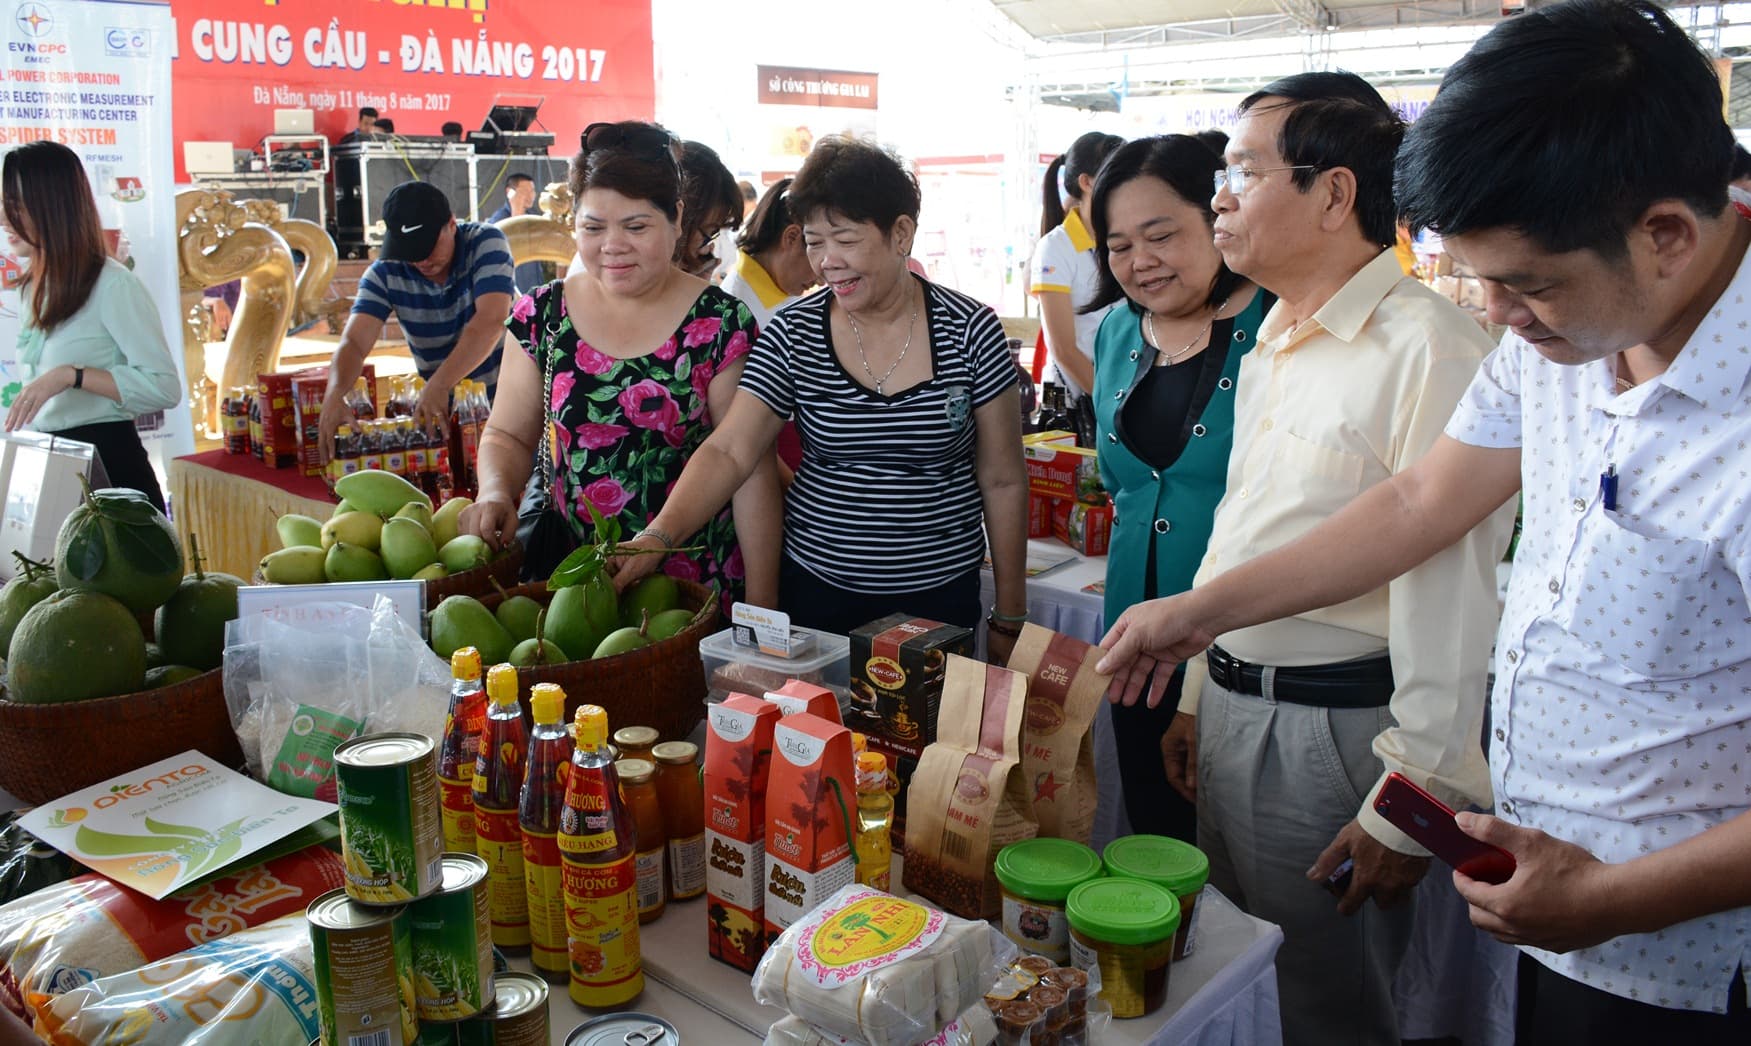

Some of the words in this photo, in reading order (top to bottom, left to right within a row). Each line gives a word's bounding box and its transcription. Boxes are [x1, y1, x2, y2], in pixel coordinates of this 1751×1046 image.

[191, 18, 293, 66] CUNG
[303, 16, 367, 71] CẦU
[399, 28, 445, 75] ĐÀ
[451, 29, 535, 80] NẴNG
[541, 44, 607, 82] 2017
[7, 70, 45, 83] POWER
[47, 72, 121, 86] CORPORATION
[13, 90, 78, 105] ELECTRONIC
[80, 92, 155, 107] MEASUREMENT
[253, 86, 271, 106] Đà
[308, 93, 338, 112] ngày
[339, 90, 353, 108] 11
[356, 91, 388, 113] tháng
[389, 92, 398, 109] 8
[424, 93, 452, 111] 2017
[7, 106, 97, 121] MANUFACTURING
[98, 108, 138, 121] CENTER
[0, 127, 52, 145] SPIDER
[57, 128, 117, 146] SYSTEM
[1039, 668, 1070, 687] CAFE
[1047, 662, 1069, 676] NEW
[571, 791, 606, 811] HƯƠNG
[567, 874, 619, 890] HƯƠNG
[829, 926, 872, 957] LAN
[871, 902, 910, 925] NHI
